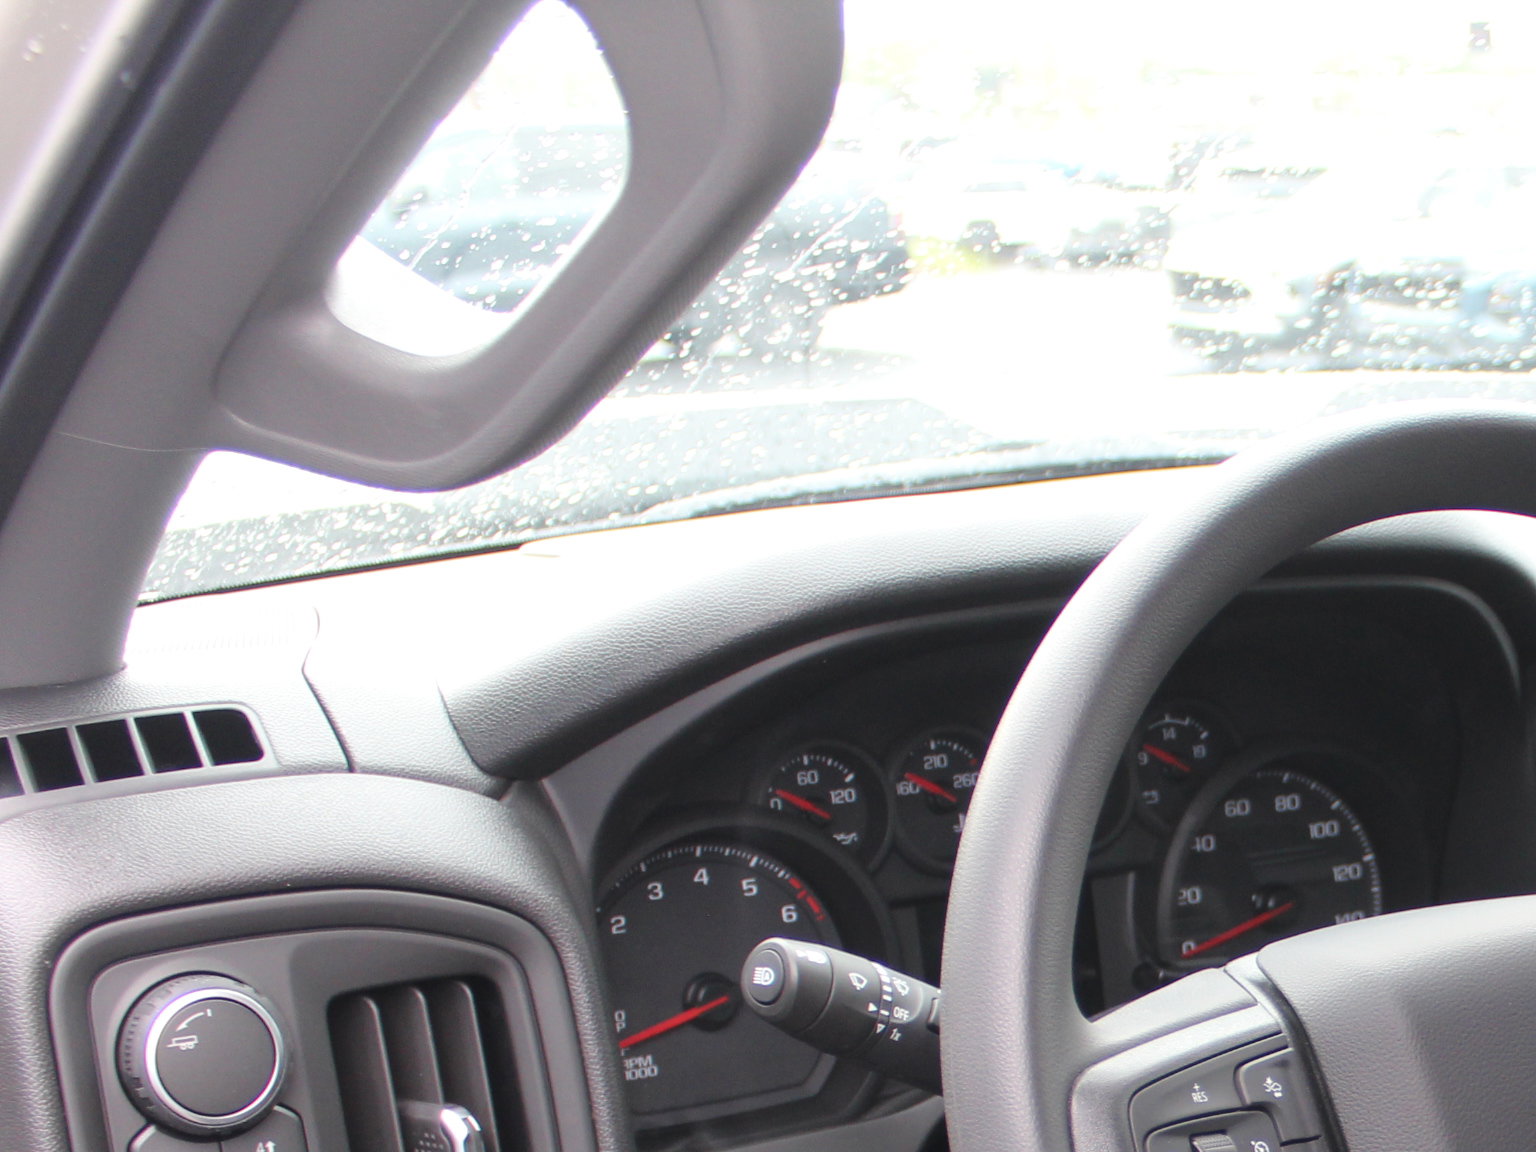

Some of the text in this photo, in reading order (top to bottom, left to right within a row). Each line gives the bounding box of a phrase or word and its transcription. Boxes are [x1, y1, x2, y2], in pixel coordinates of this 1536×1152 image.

[923, 753, 948, 770] 210
[797, 769, 819, 786] 60
[952, 772, 979, 789] 260
[830, 788, 856, 804] 120
[1274, 793, 1301, 813] 80
[1224, 798, 1250, 817] 60
[1308, 819, 1340, 839] 100
[693, 868, 710, 886] 4
[1332, 863, 1362, 882] 120
[647, 882, 664, 900] 3
[741, 878, 758, 897] 5
[780, 904, 798, 923] 6
[610, 915, 627, 935] 2
[893, 1006, 911, 1021] OFF
[1191, 1091, 1208, 1104] RES
